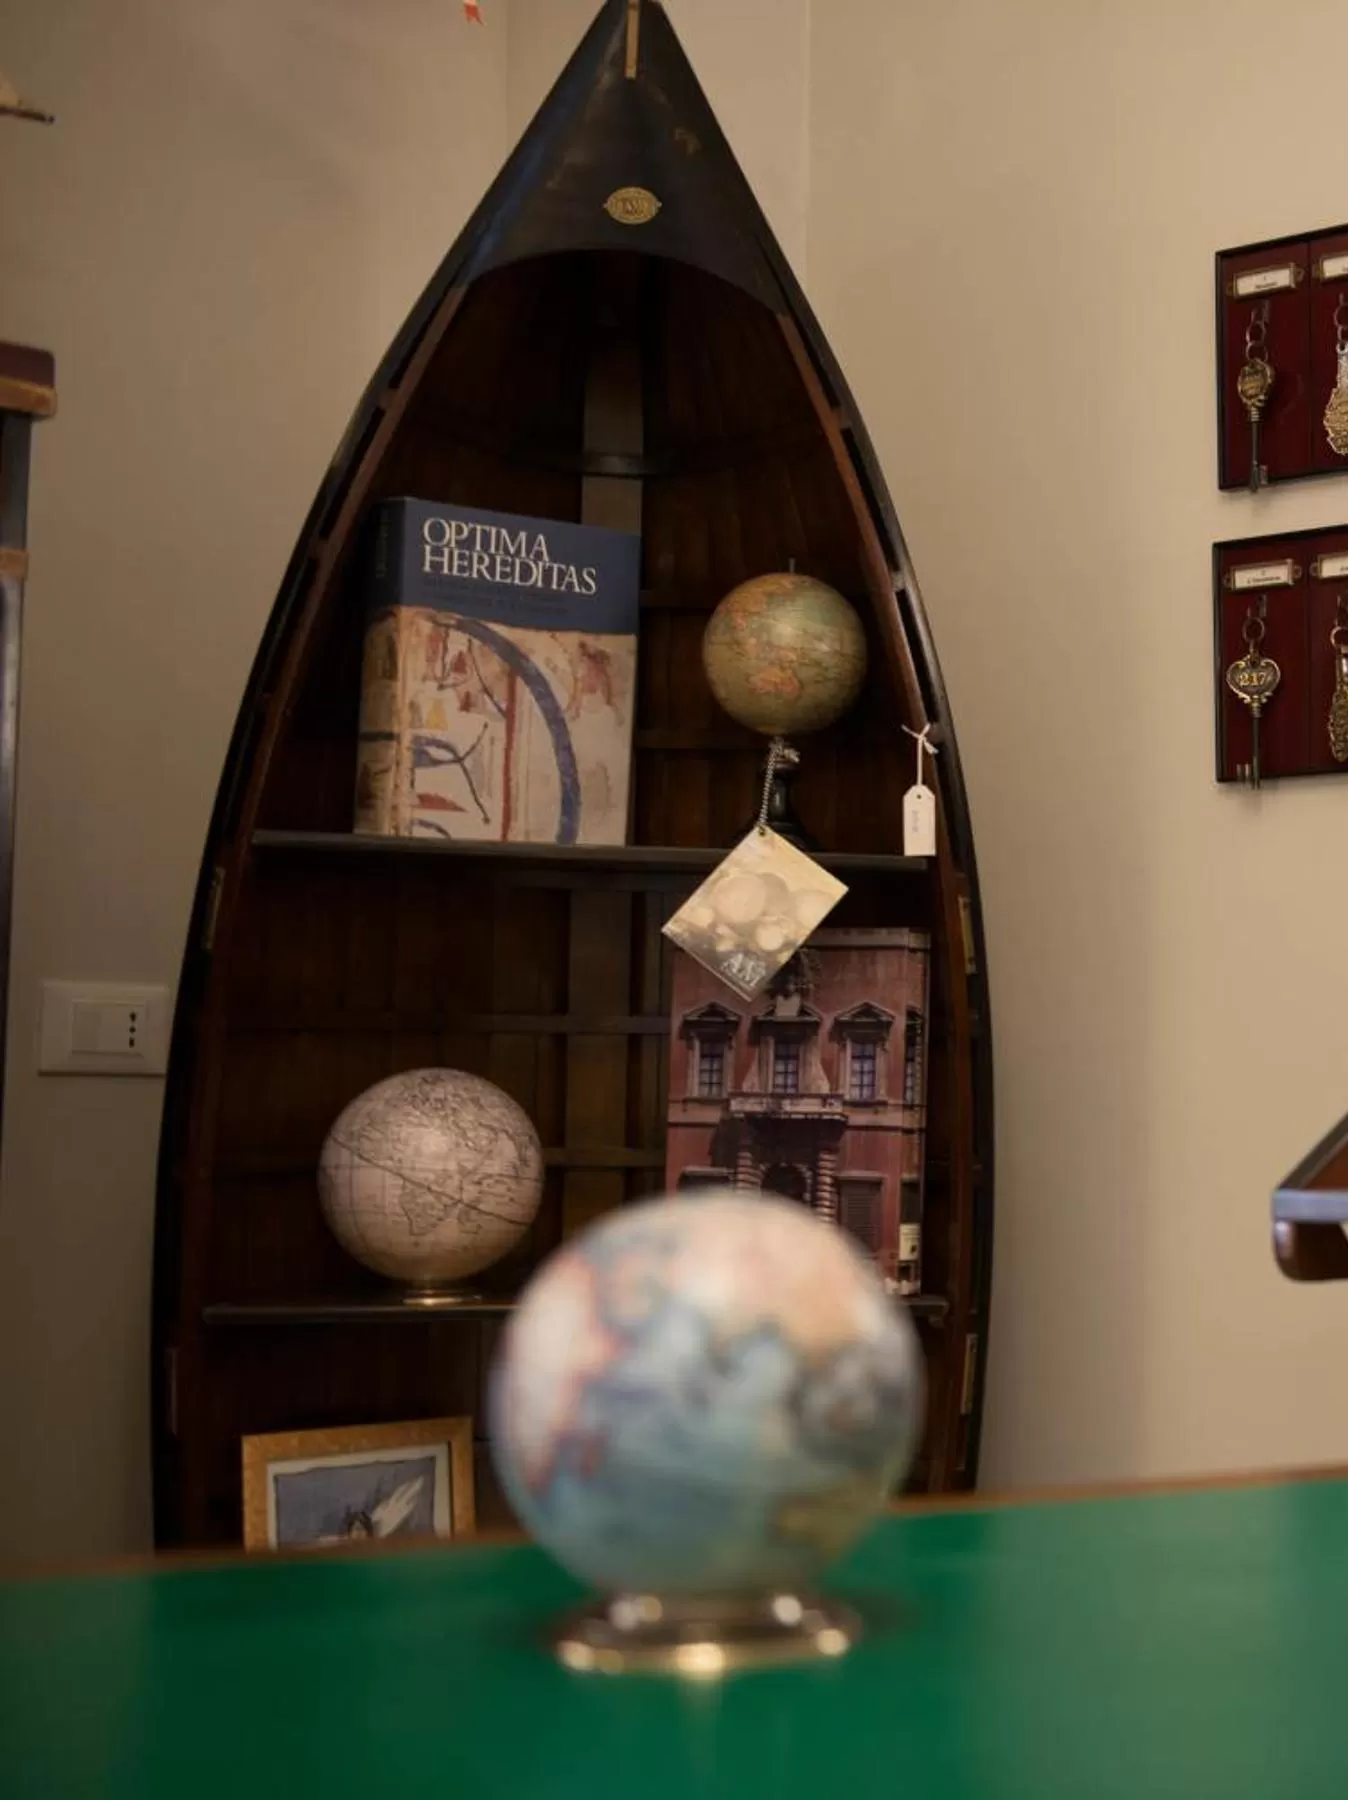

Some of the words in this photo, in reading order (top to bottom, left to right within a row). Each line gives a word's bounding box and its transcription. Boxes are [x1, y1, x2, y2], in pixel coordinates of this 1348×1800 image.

[423, 517, 550, 562] OPTIMA
[422, 544, 597, 596] HEREDITAS
[1239, 671, 1267, 687] 217
